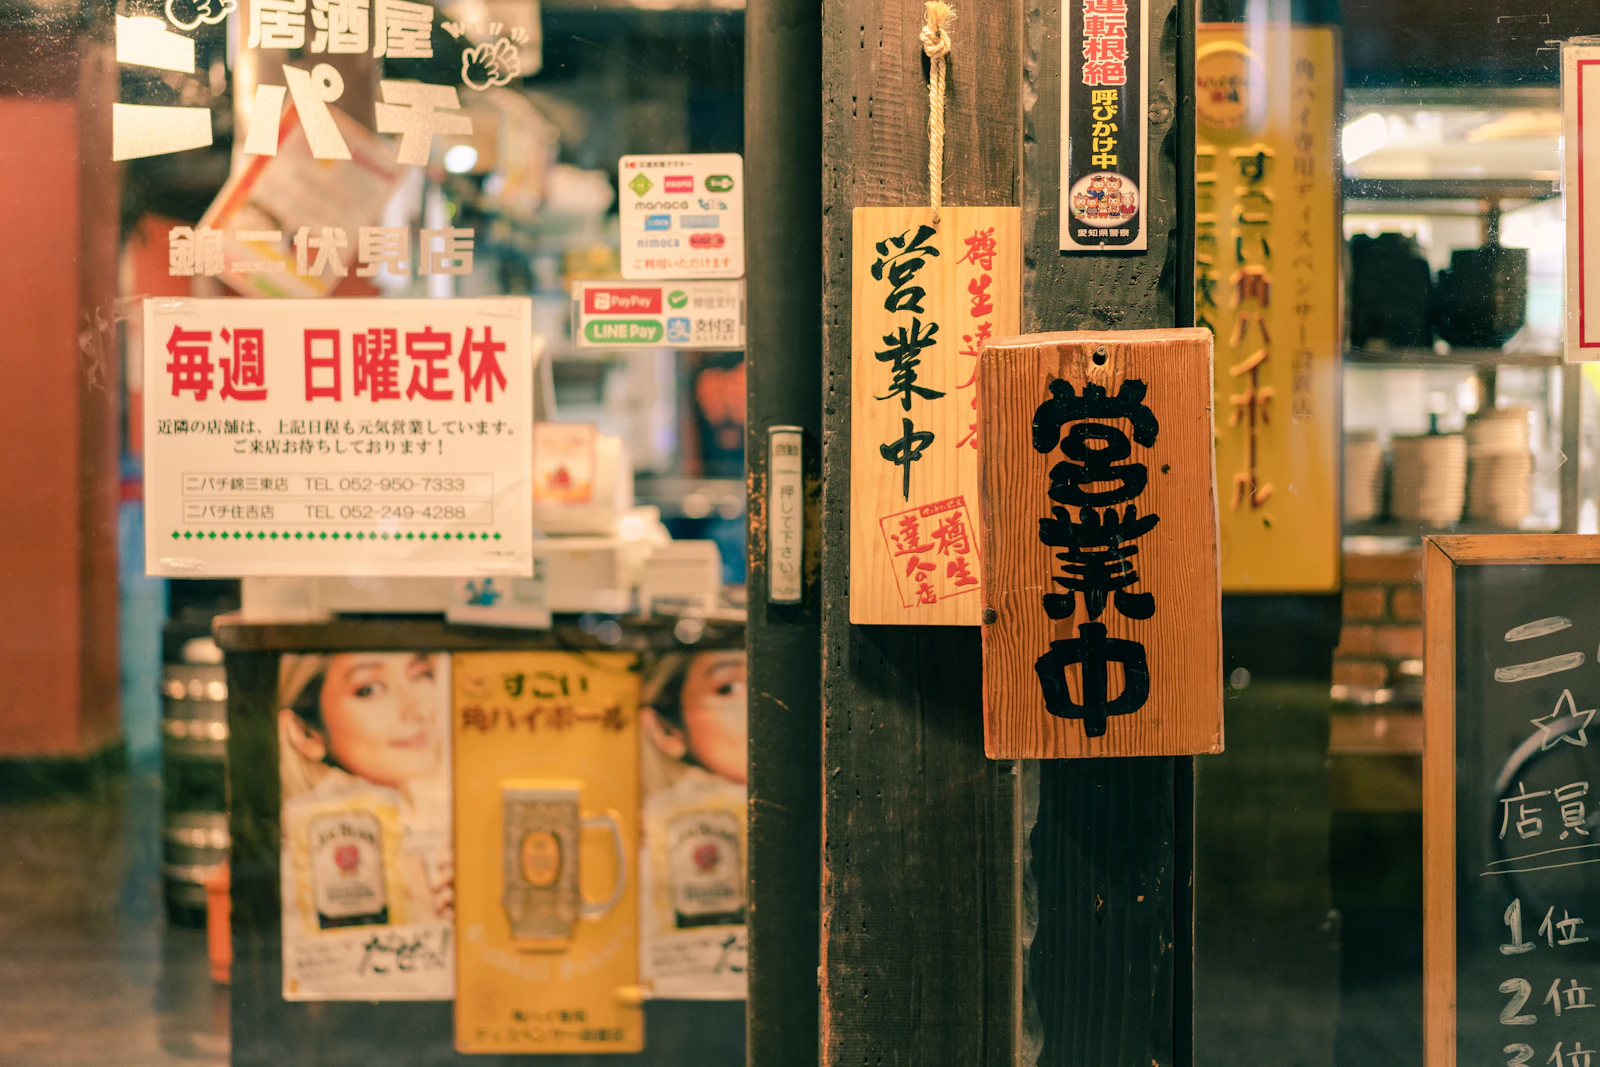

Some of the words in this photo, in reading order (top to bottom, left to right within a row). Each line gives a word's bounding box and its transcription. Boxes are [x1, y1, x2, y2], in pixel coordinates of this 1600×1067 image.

[248, 0, 435, 59] 居酒屋
[1082, 0, 1129, 86] 運転根絶
[1091, 88, 1118, 170] 呼びかけ中
[635, 201, 689, 211] manaca
[1077, 228, 1130, 238] 愛知県警察
[168, 226, 475, 277] 錦二伏見店
[637, 237, 680, 249] nimoca
[611, 294, 652, 308] PayPay
[593, 324, 628, 338] LINE
[630, 324, 657, 340] Pay
[955, 227, 998, 450] 樽生達
[166, 324, 268, 402] 毎週
[303, 325, 508, 402] 日曜定休
[870, 224, 947, 502] 営業中
[304, 477, 335, 492] TEL
[339, 477, 466, 492] 052-950-7333
[304, 504, 335, 519] TEL
[339, 504, 466, 519] 052-249-4288
[780, 484, 795, 575] 押して下さい
[930, 511, 979, 586] 樽生
[1032, 378, 1161, 738] 営業中
[1499, 781, 1590, 840] 店員
[1499, 897, 1590, 956] 1位
[1499, 977, 1597, 1026] 2位
